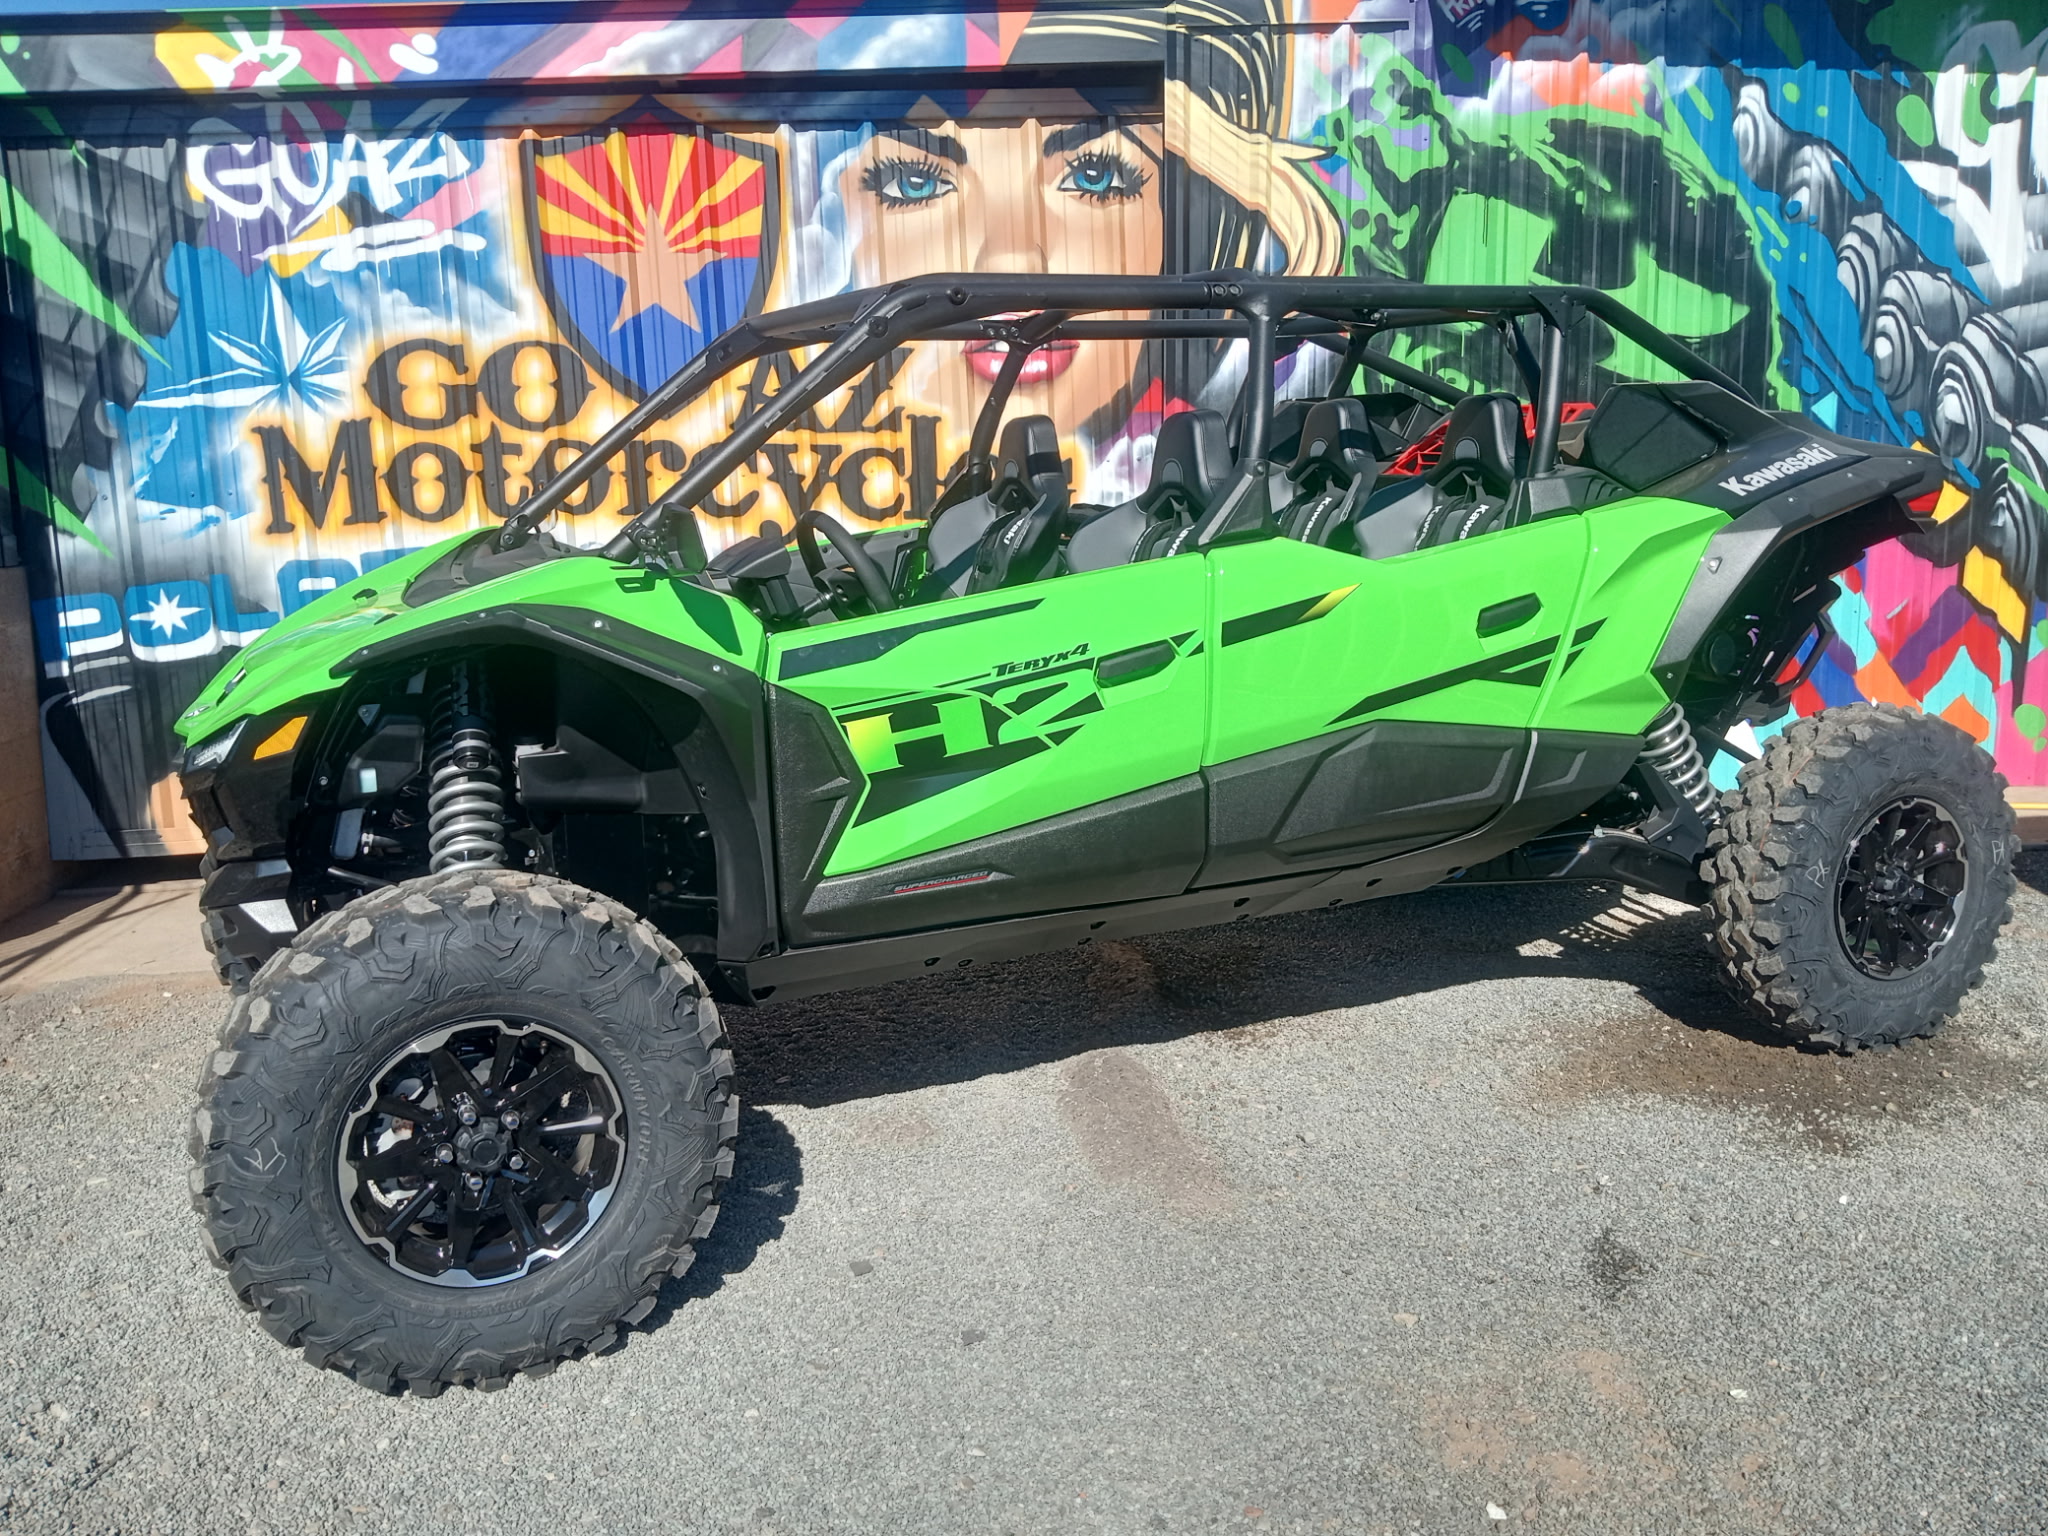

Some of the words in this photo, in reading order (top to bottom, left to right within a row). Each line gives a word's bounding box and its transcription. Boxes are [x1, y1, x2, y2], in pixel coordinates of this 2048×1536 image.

[363, 338, 596, 432] GO
[1718, 443, 1838, 496] Kawasaki
[841, 667, 1105, 775] H2
[894, 870, 989, 893] SUPERCHARGED
